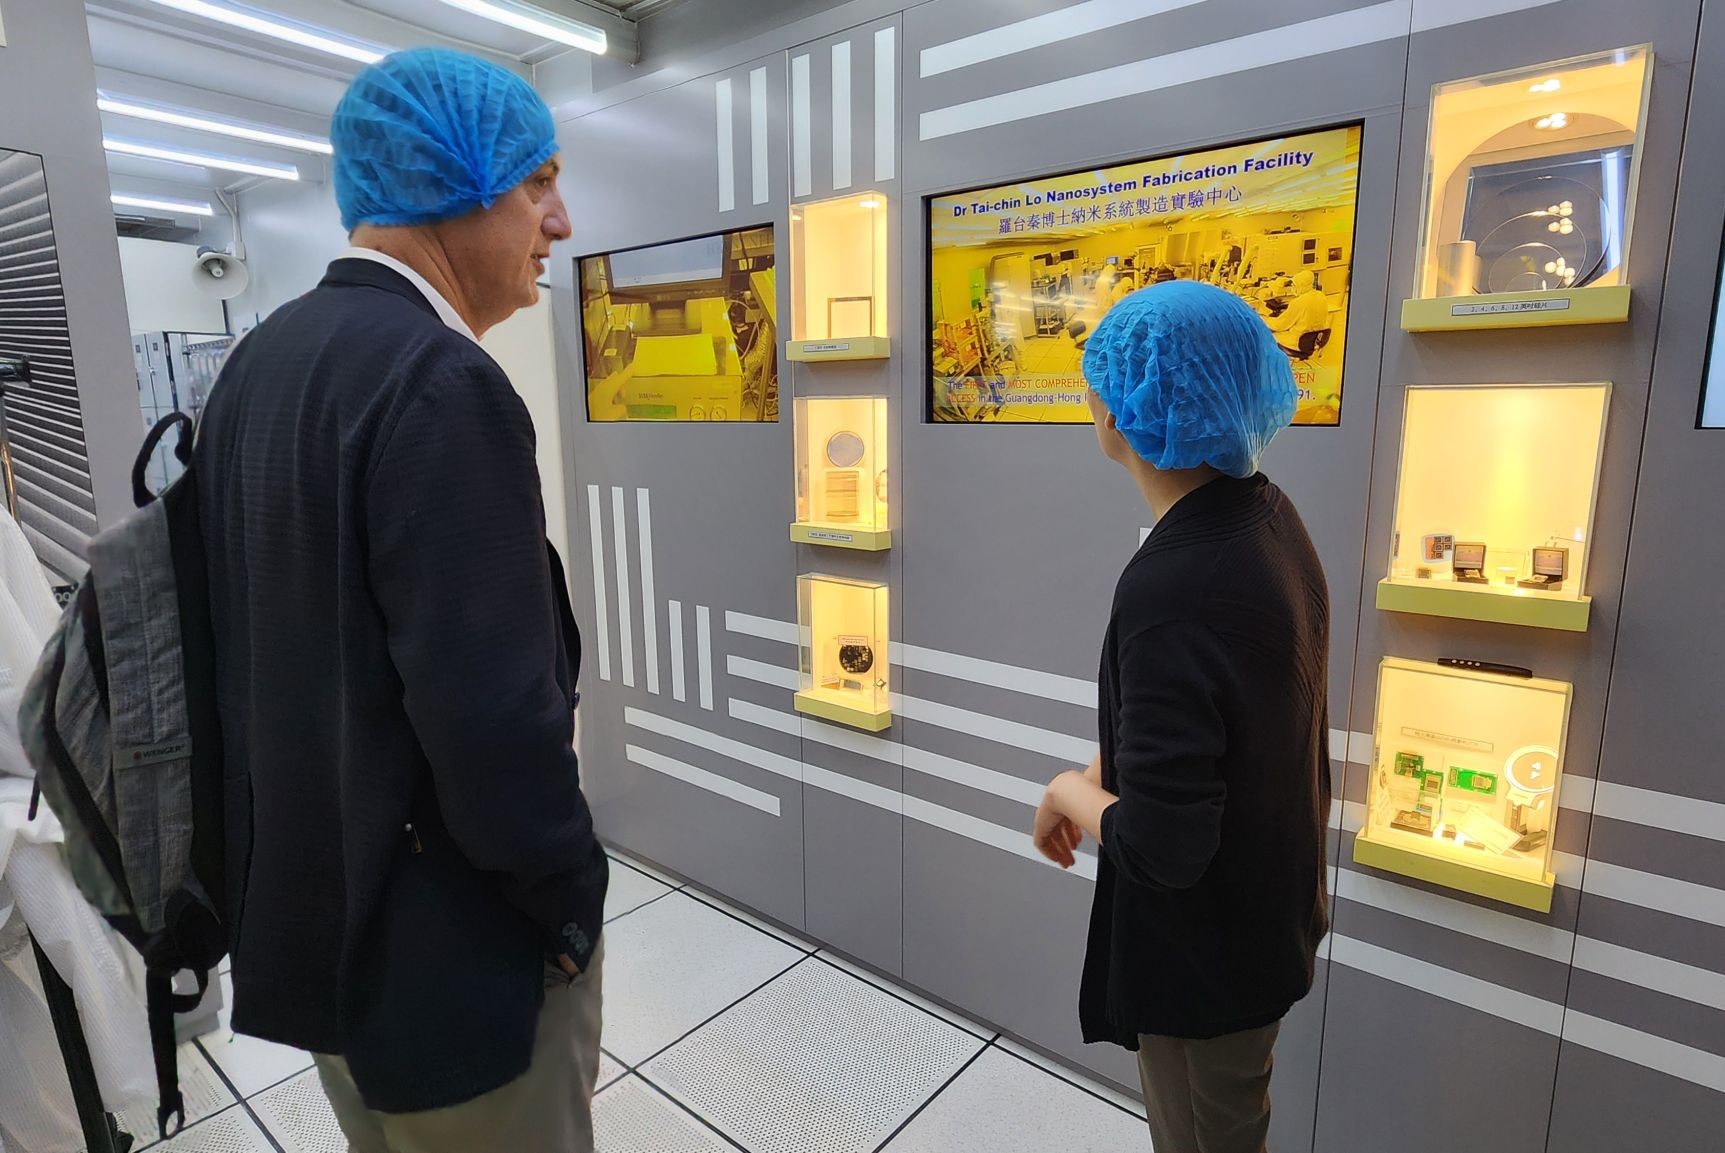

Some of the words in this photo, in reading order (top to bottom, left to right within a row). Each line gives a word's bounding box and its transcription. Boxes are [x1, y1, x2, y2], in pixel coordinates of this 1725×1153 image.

[953, 205, 967, 217] Dr
[971, 198, 1021, 214] Tai-chin
[1026, 195, 1042, 206] Lo
[1046, 181, 1137, 203] Nanosystem
[1142, 164, 1238, 188] Fabrication
[1243, 151, 1314, 173] Facility
[999, 185, 1243, 235] 羅台秦博士納米系統製造實驗中心
[978, 393, 986, 402] in
[1005, 392, 1082, 405] Guangdong-Hong
[1008, 378, 1032, 389] MOST
